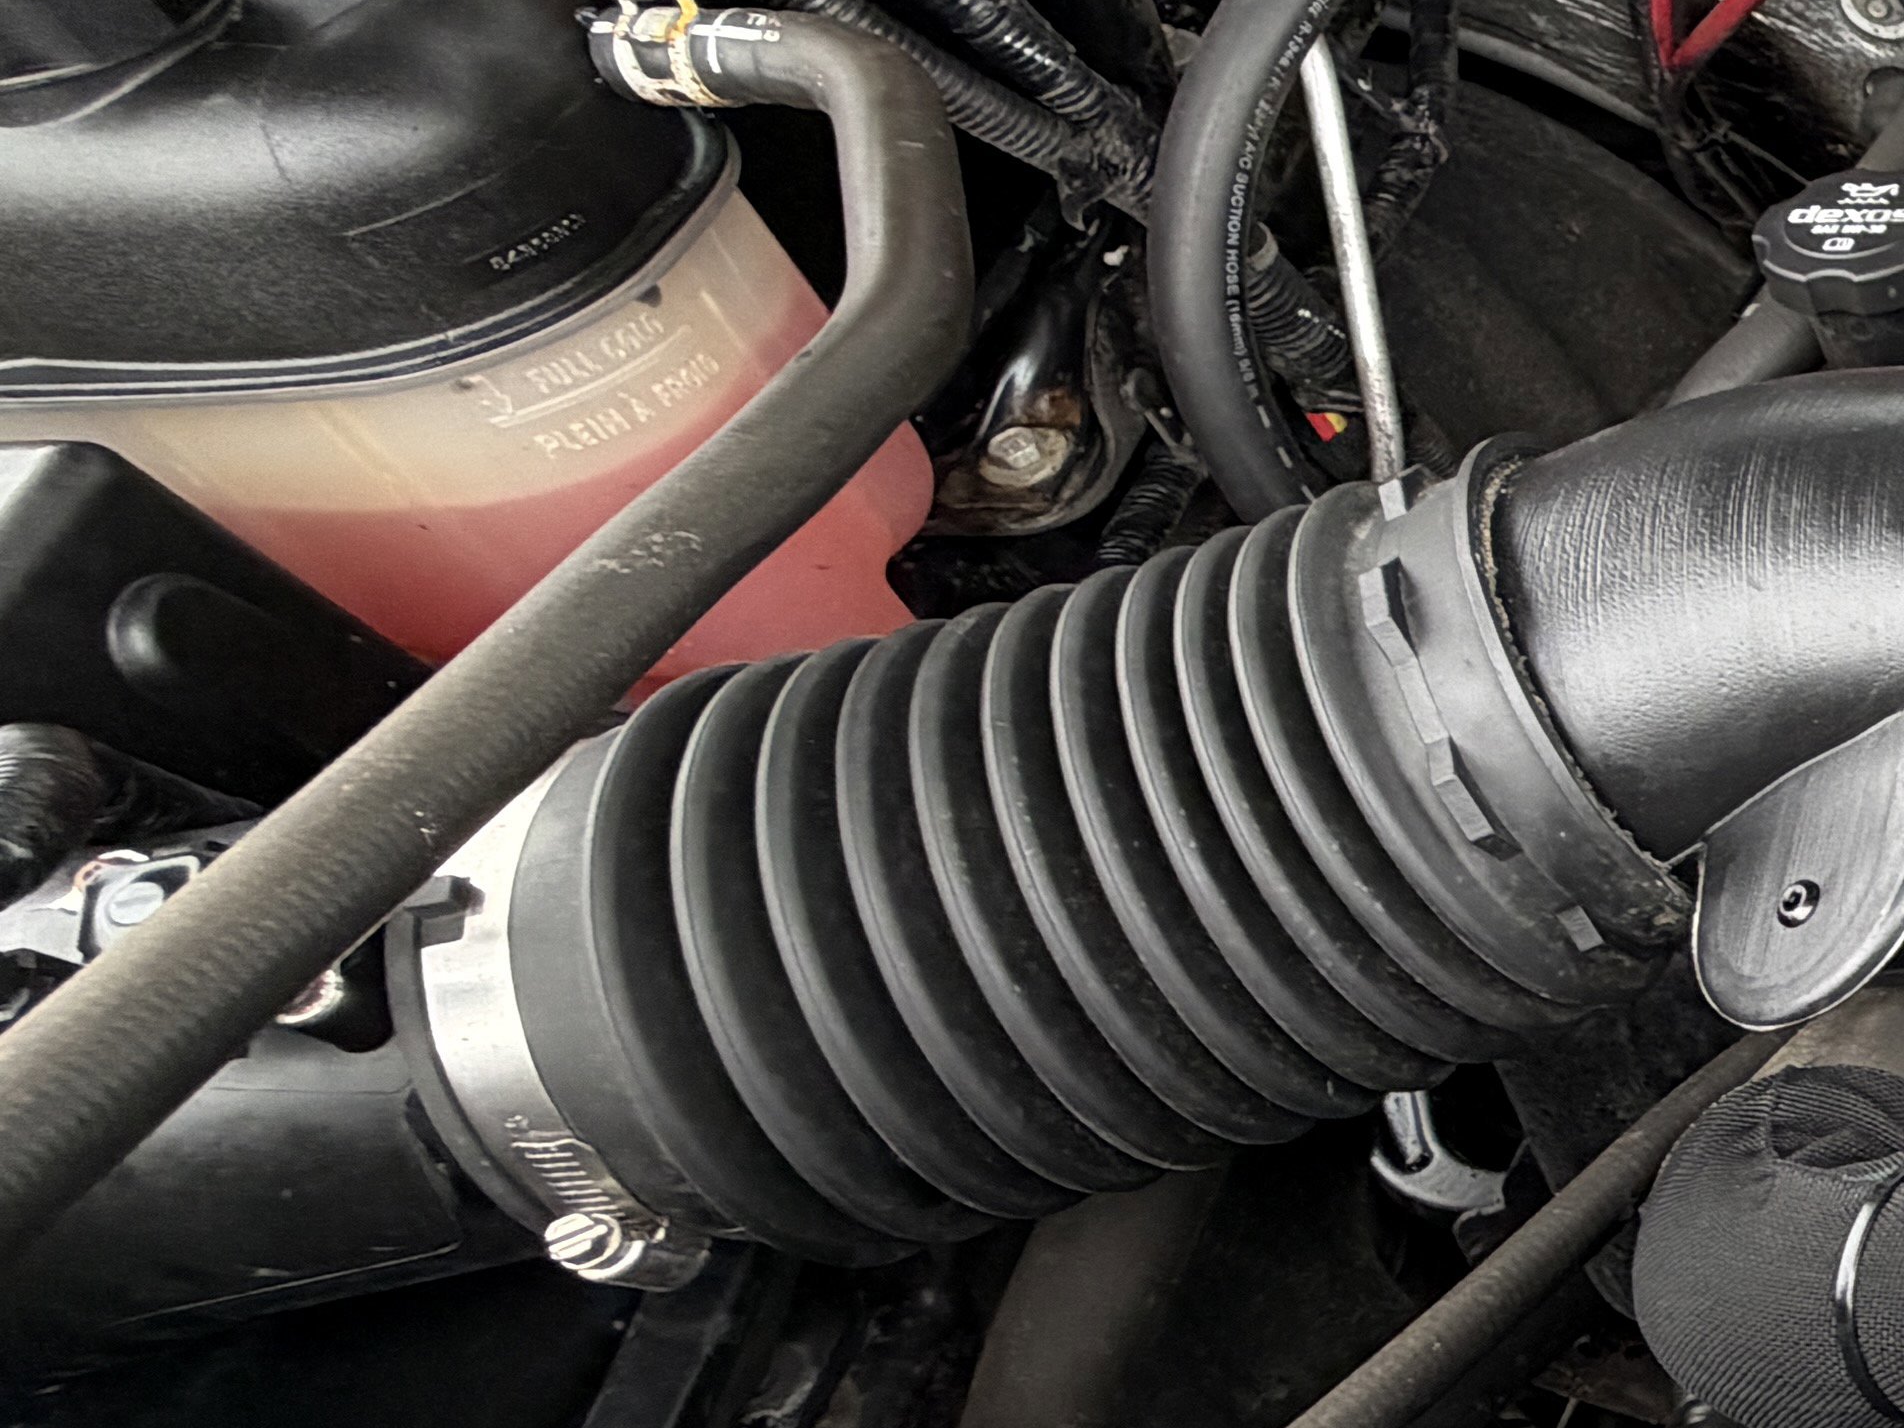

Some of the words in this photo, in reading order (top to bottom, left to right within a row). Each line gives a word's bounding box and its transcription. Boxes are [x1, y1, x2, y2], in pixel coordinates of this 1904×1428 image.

[1226, 172, 1250, 246] SUCTION
[1225, 248, 1241, 296] HOSE
[526, 351, 603, 394] FULL
[533, 408, 632, 459] PLEIN
